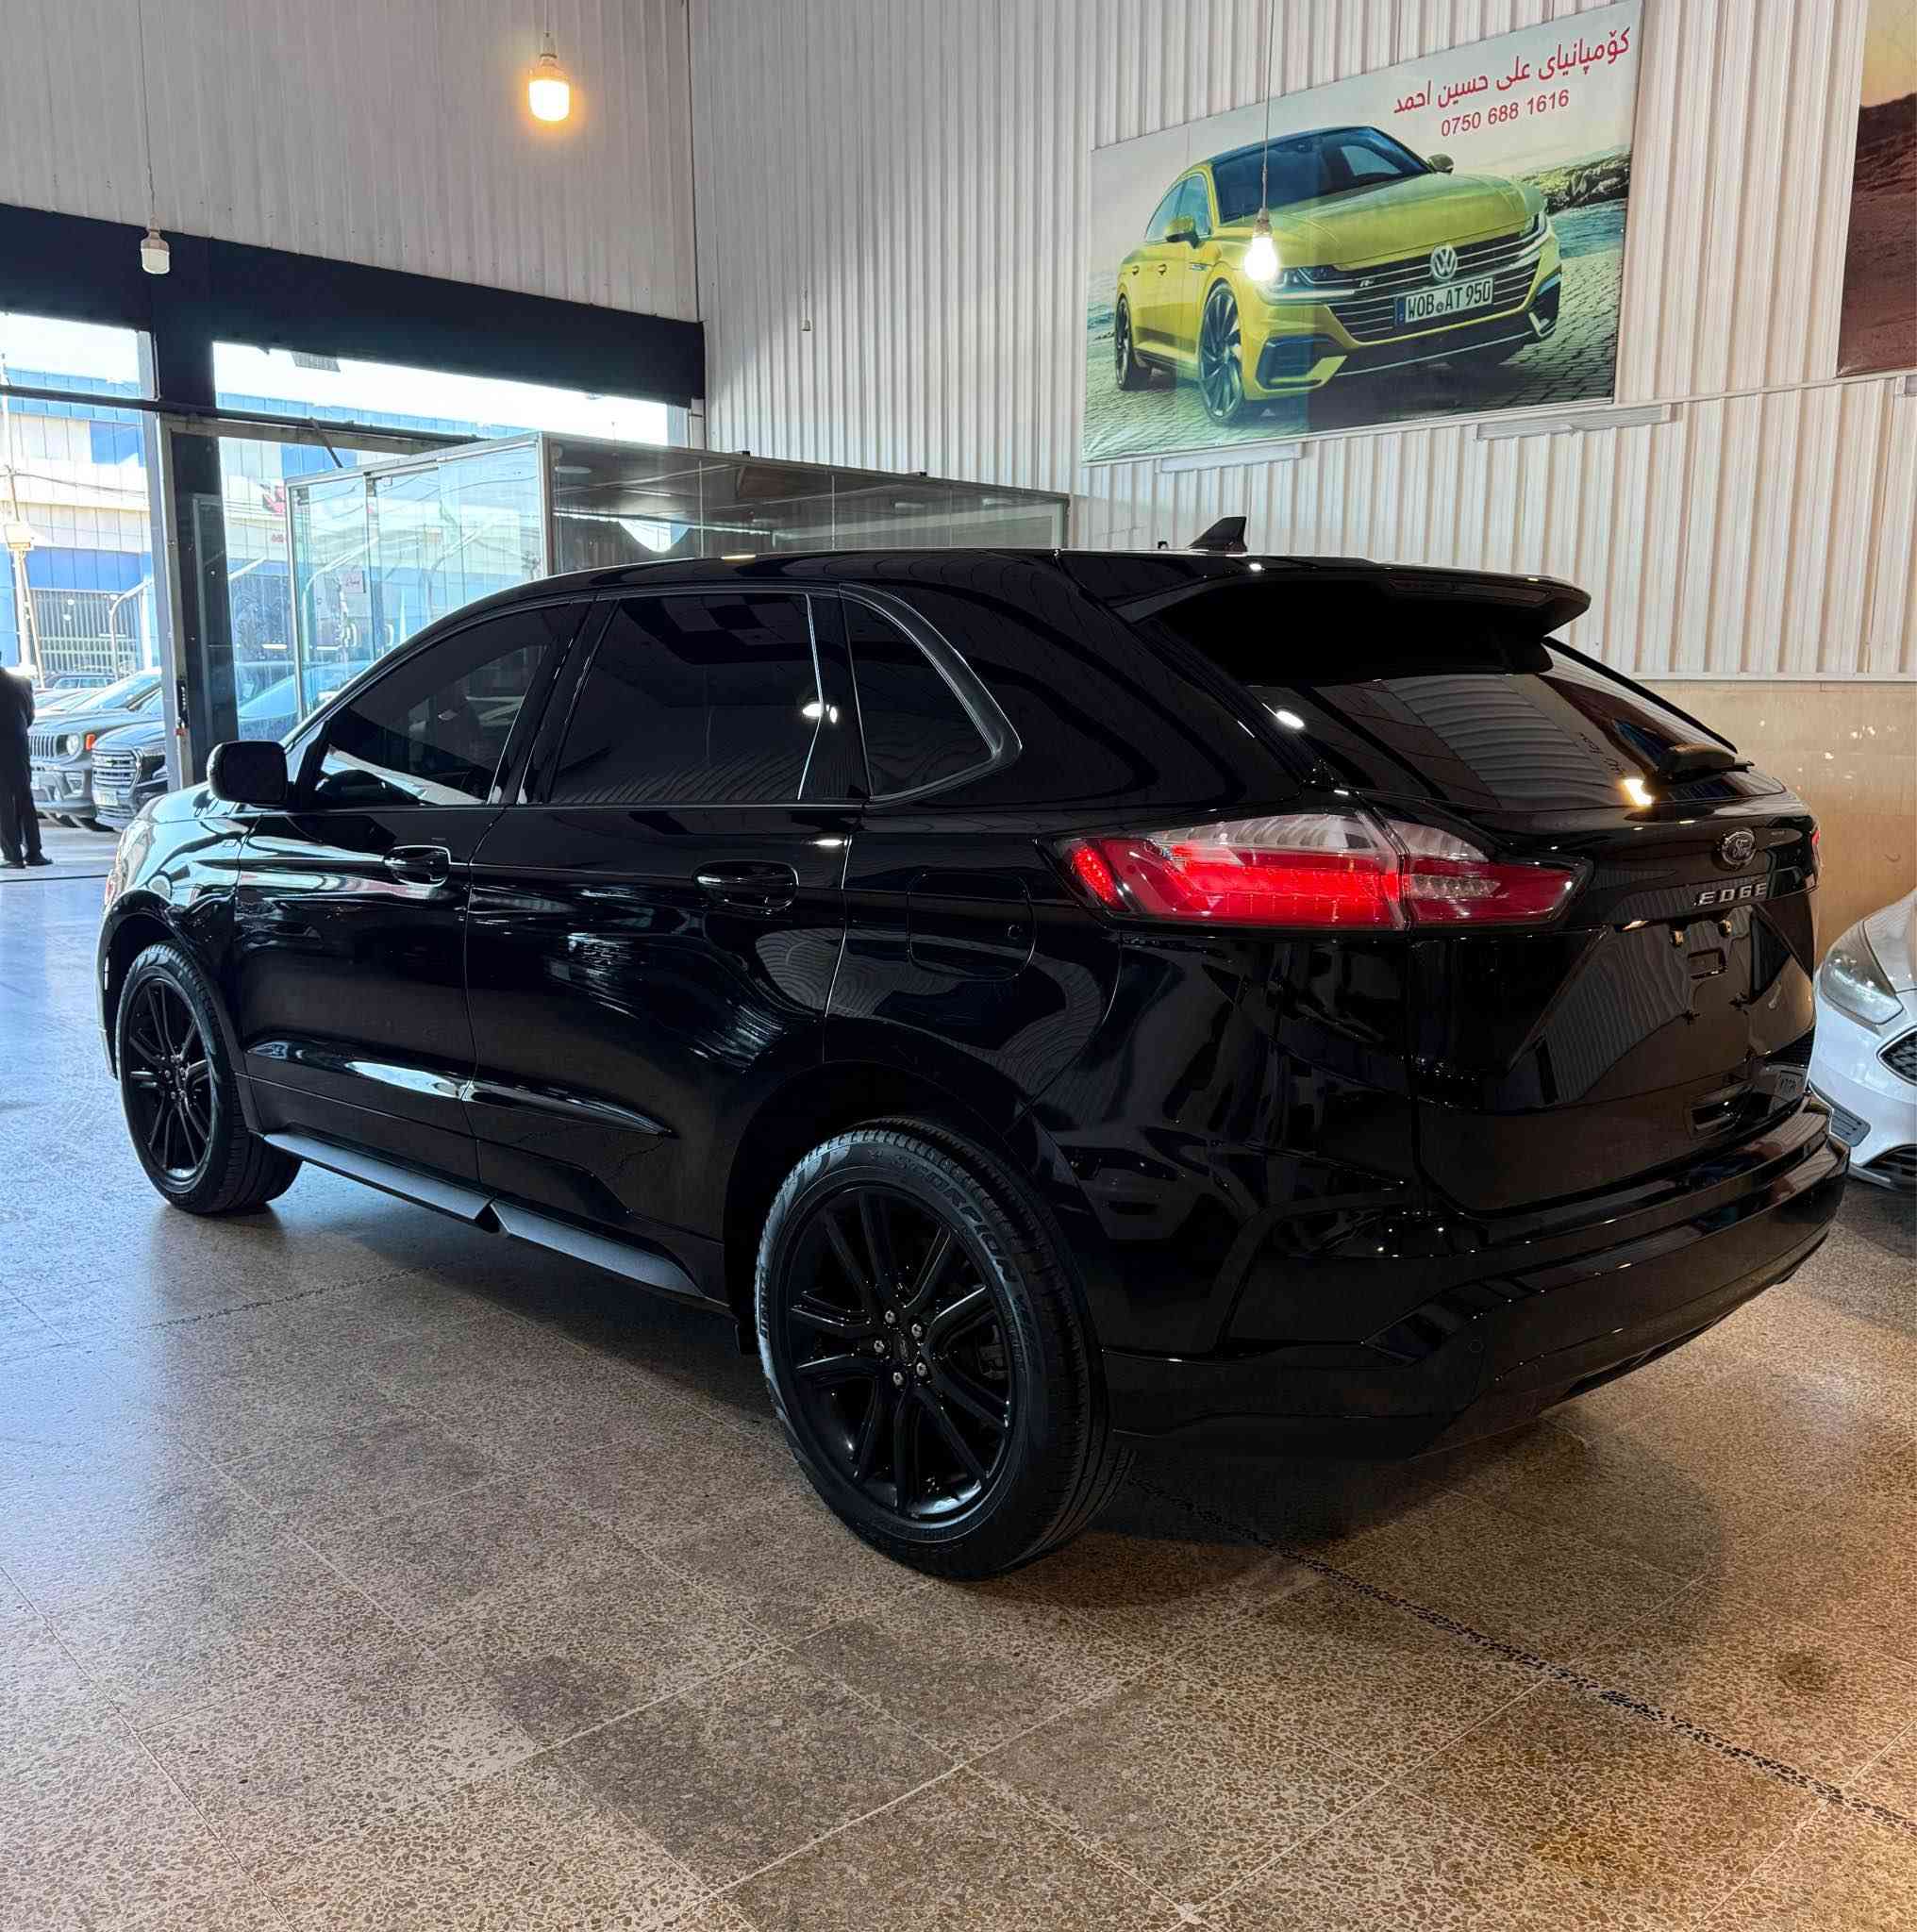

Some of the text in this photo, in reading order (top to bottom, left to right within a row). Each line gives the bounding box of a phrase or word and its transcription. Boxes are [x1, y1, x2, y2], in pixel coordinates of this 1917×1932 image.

[1393, 79, 1432, 113] احمد
[1441, 89, 1570, 137] 0750 688 1616
[1407, 280, 1492, 320] WOB AT 950
[1697, 882, 1767, 907] EDGE
